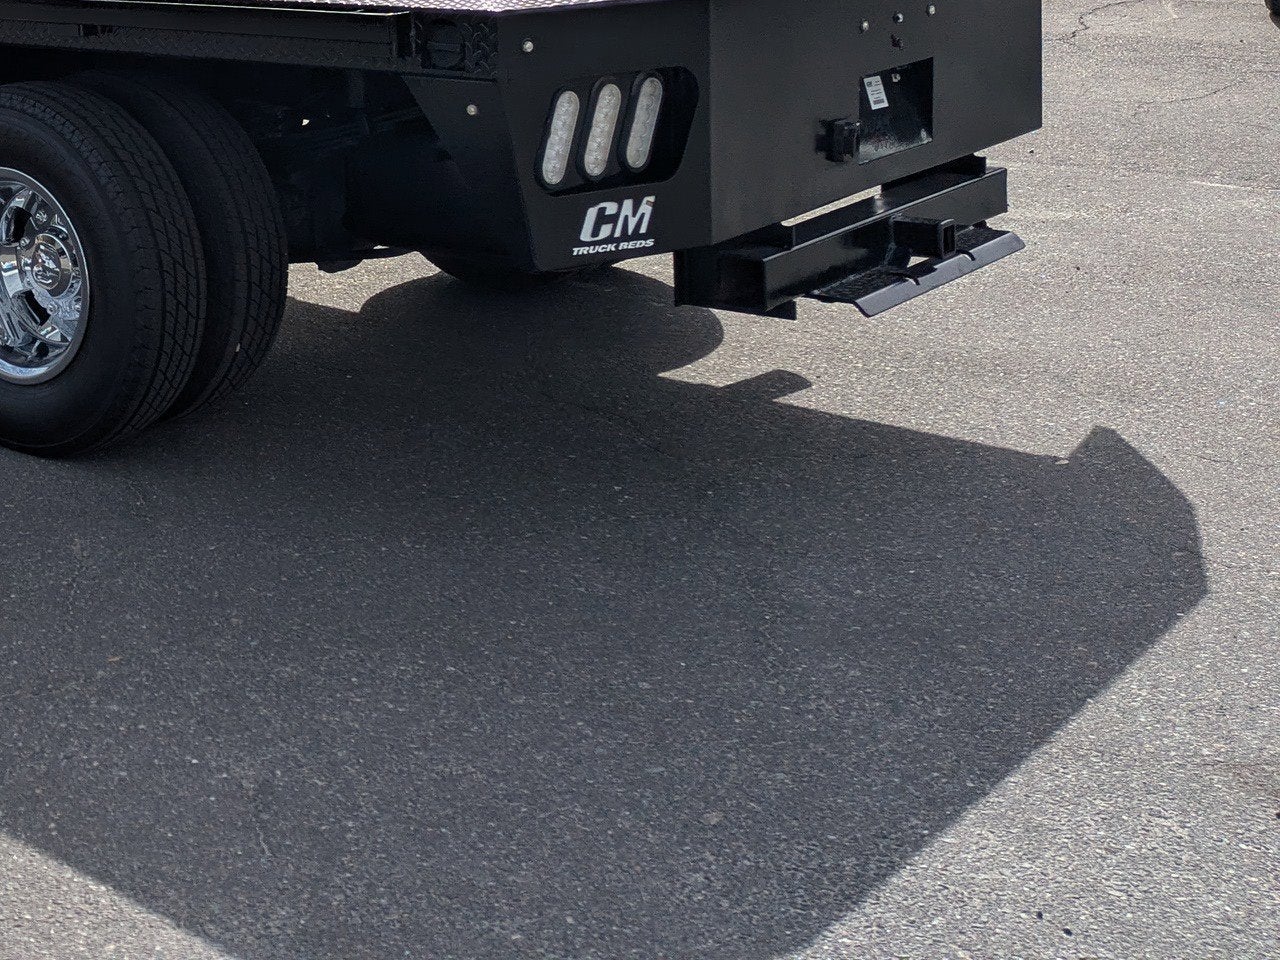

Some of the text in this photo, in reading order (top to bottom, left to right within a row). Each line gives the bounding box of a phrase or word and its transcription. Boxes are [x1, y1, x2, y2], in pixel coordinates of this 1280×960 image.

[580, 195, 656, 242] CM
[572, 239, 655, 255] TRUCK BEDS
